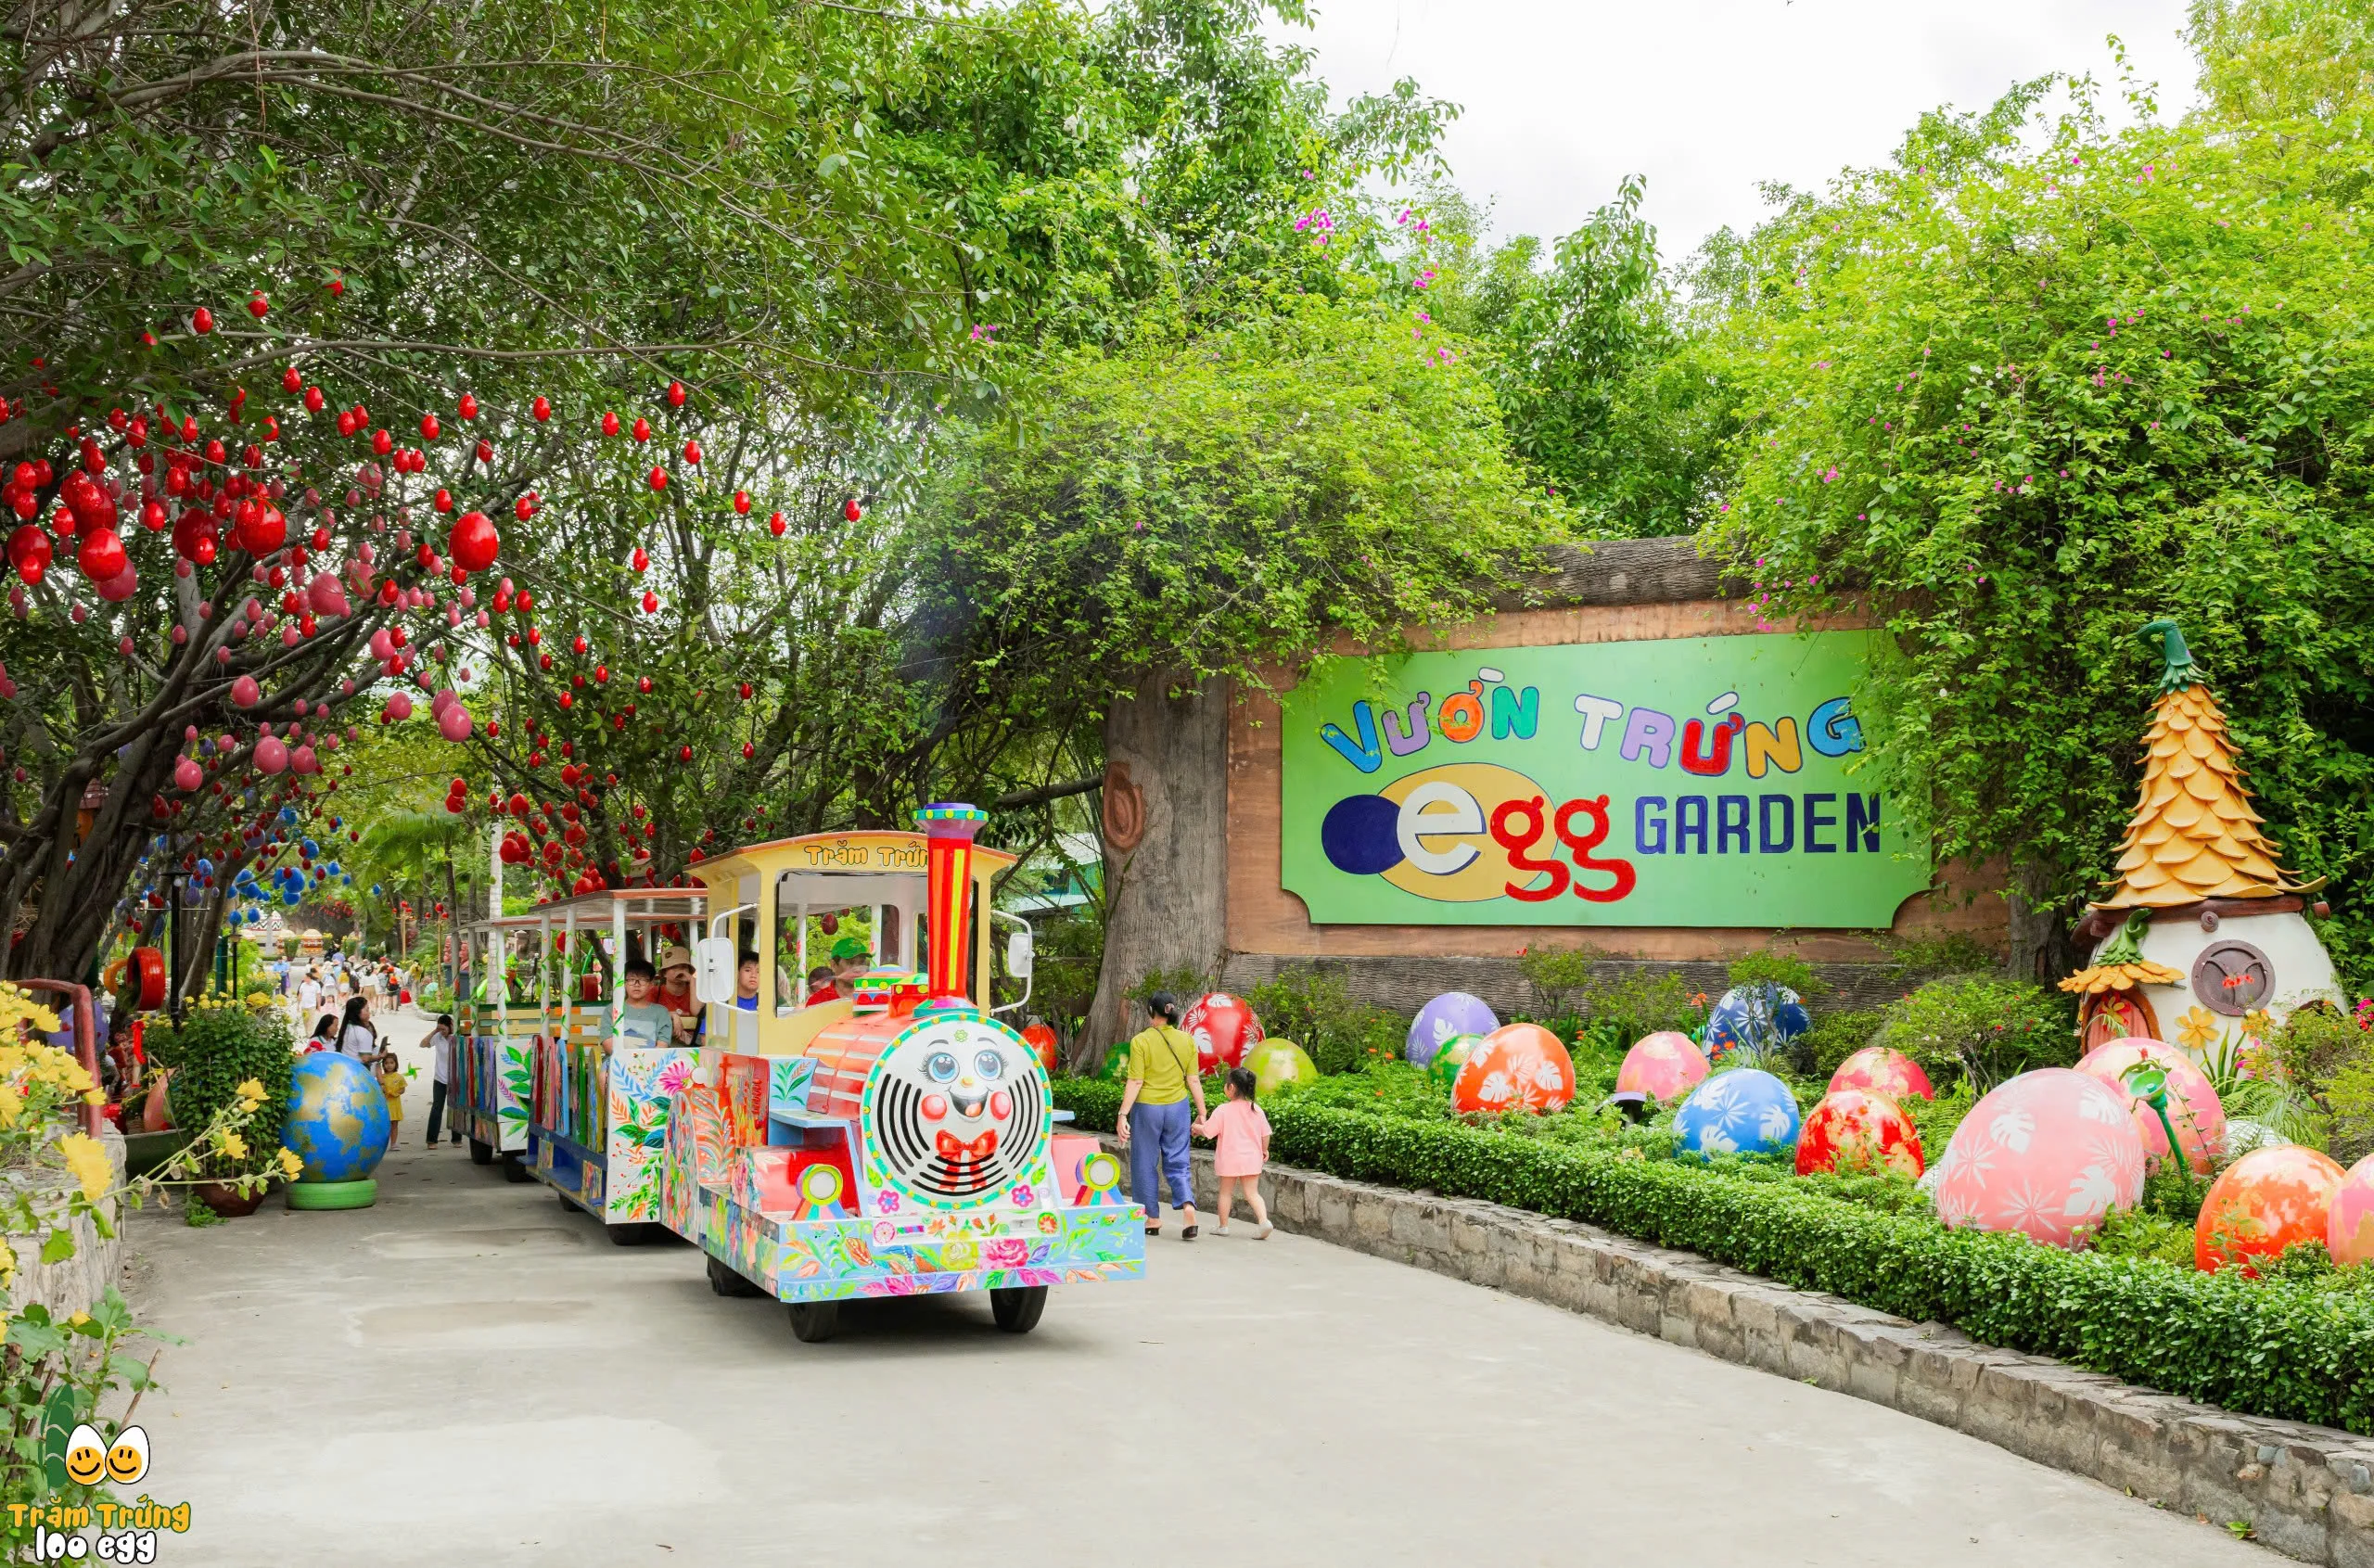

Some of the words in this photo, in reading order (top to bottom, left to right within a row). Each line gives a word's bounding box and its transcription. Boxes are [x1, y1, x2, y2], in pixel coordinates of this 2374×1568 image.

[1321, 667, 1539, 773] VƯỜN
[1574, 691, 1868, 779] TRỨNG
[803, 839, 869, 866] Trăm
[876, 840, 928, 868] Trứn
[1396, 781, 1637, 902] egg
[1634, 792, 1881, 854] GARDEN
